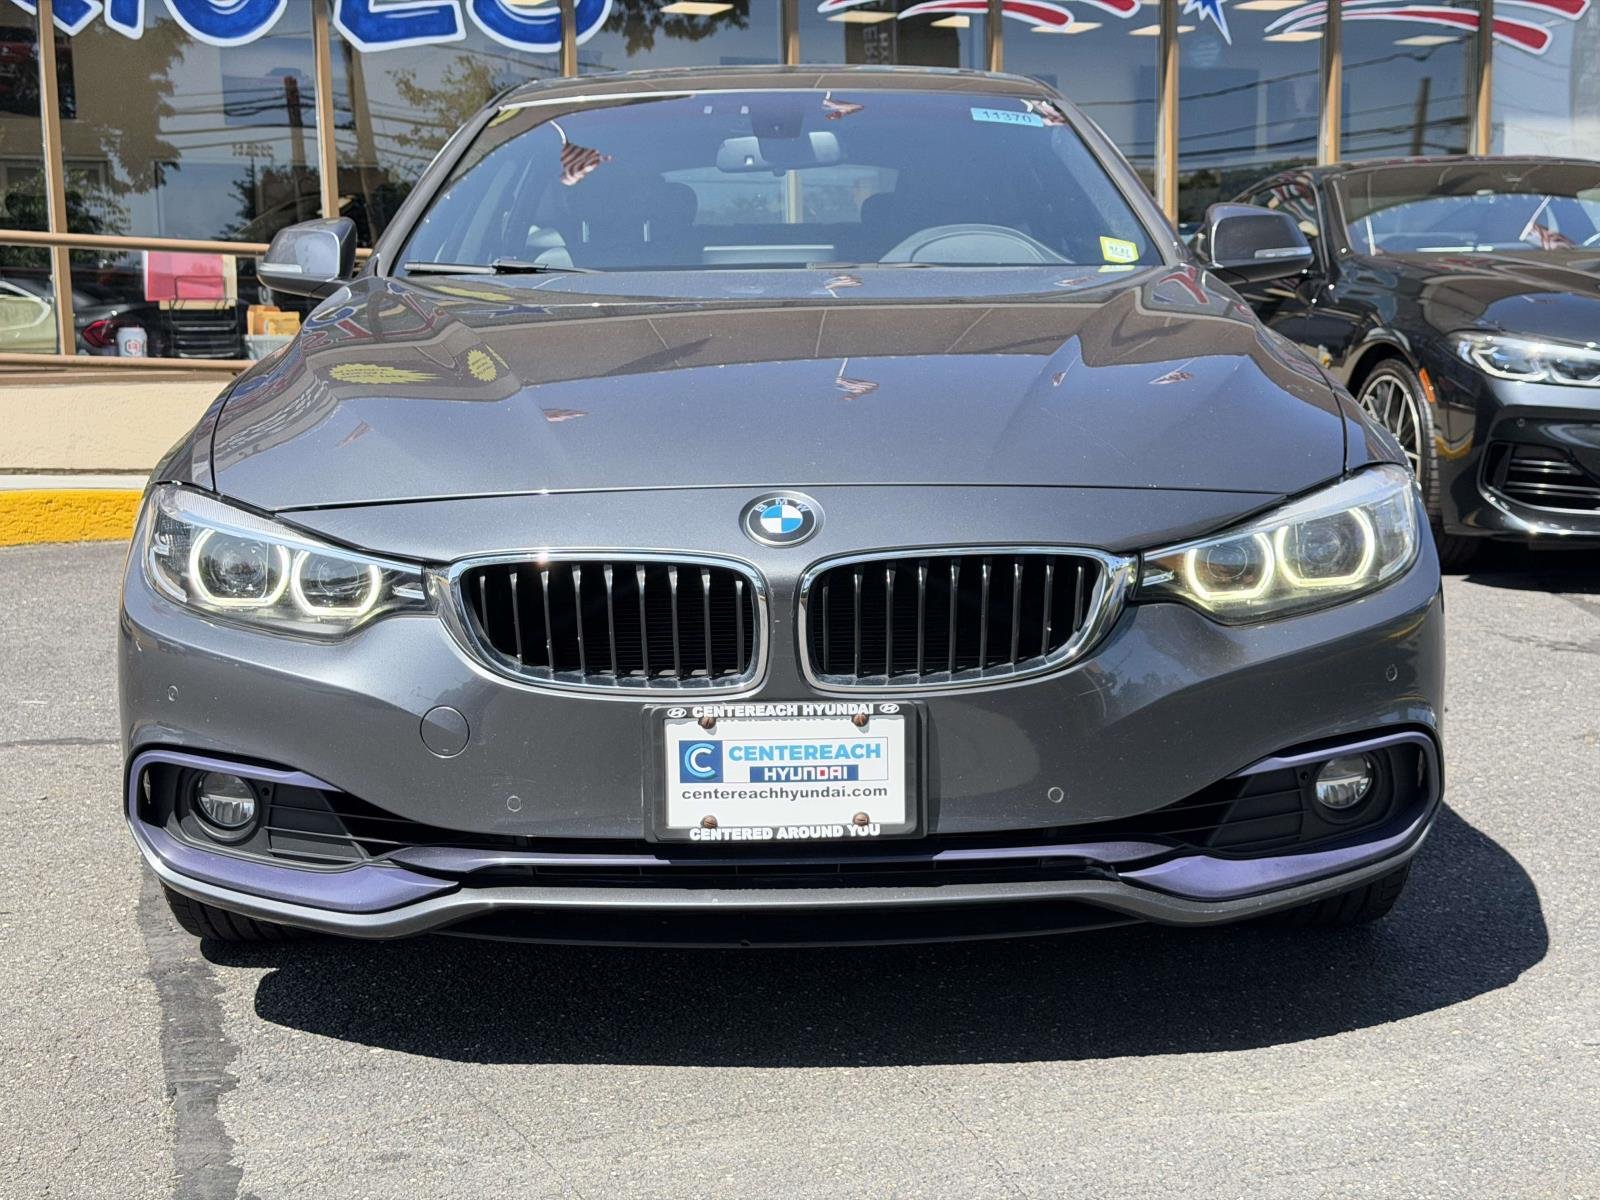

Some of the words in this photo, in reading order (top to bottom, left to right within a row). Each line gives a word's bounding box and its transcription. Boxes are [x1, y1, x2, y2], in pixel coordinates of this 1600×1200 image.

[983, 111, 1032, 123] 11370
[753, 496, 810, 513] BMW
[692, 704, 800, 718] CENTEREACH
[803, 703, 874, 716] HYUNDAI
[728, 743, 881, 762] CENTEREACH
[763, 766, 848, 781] HYUNDAI
[681, 785, 888, 802] centereachhyundai.com
[689, 826, 773, 841] CENTERED
[776, 825, 844, 840] AROUND
[846, 823, 881, 837] YOU
